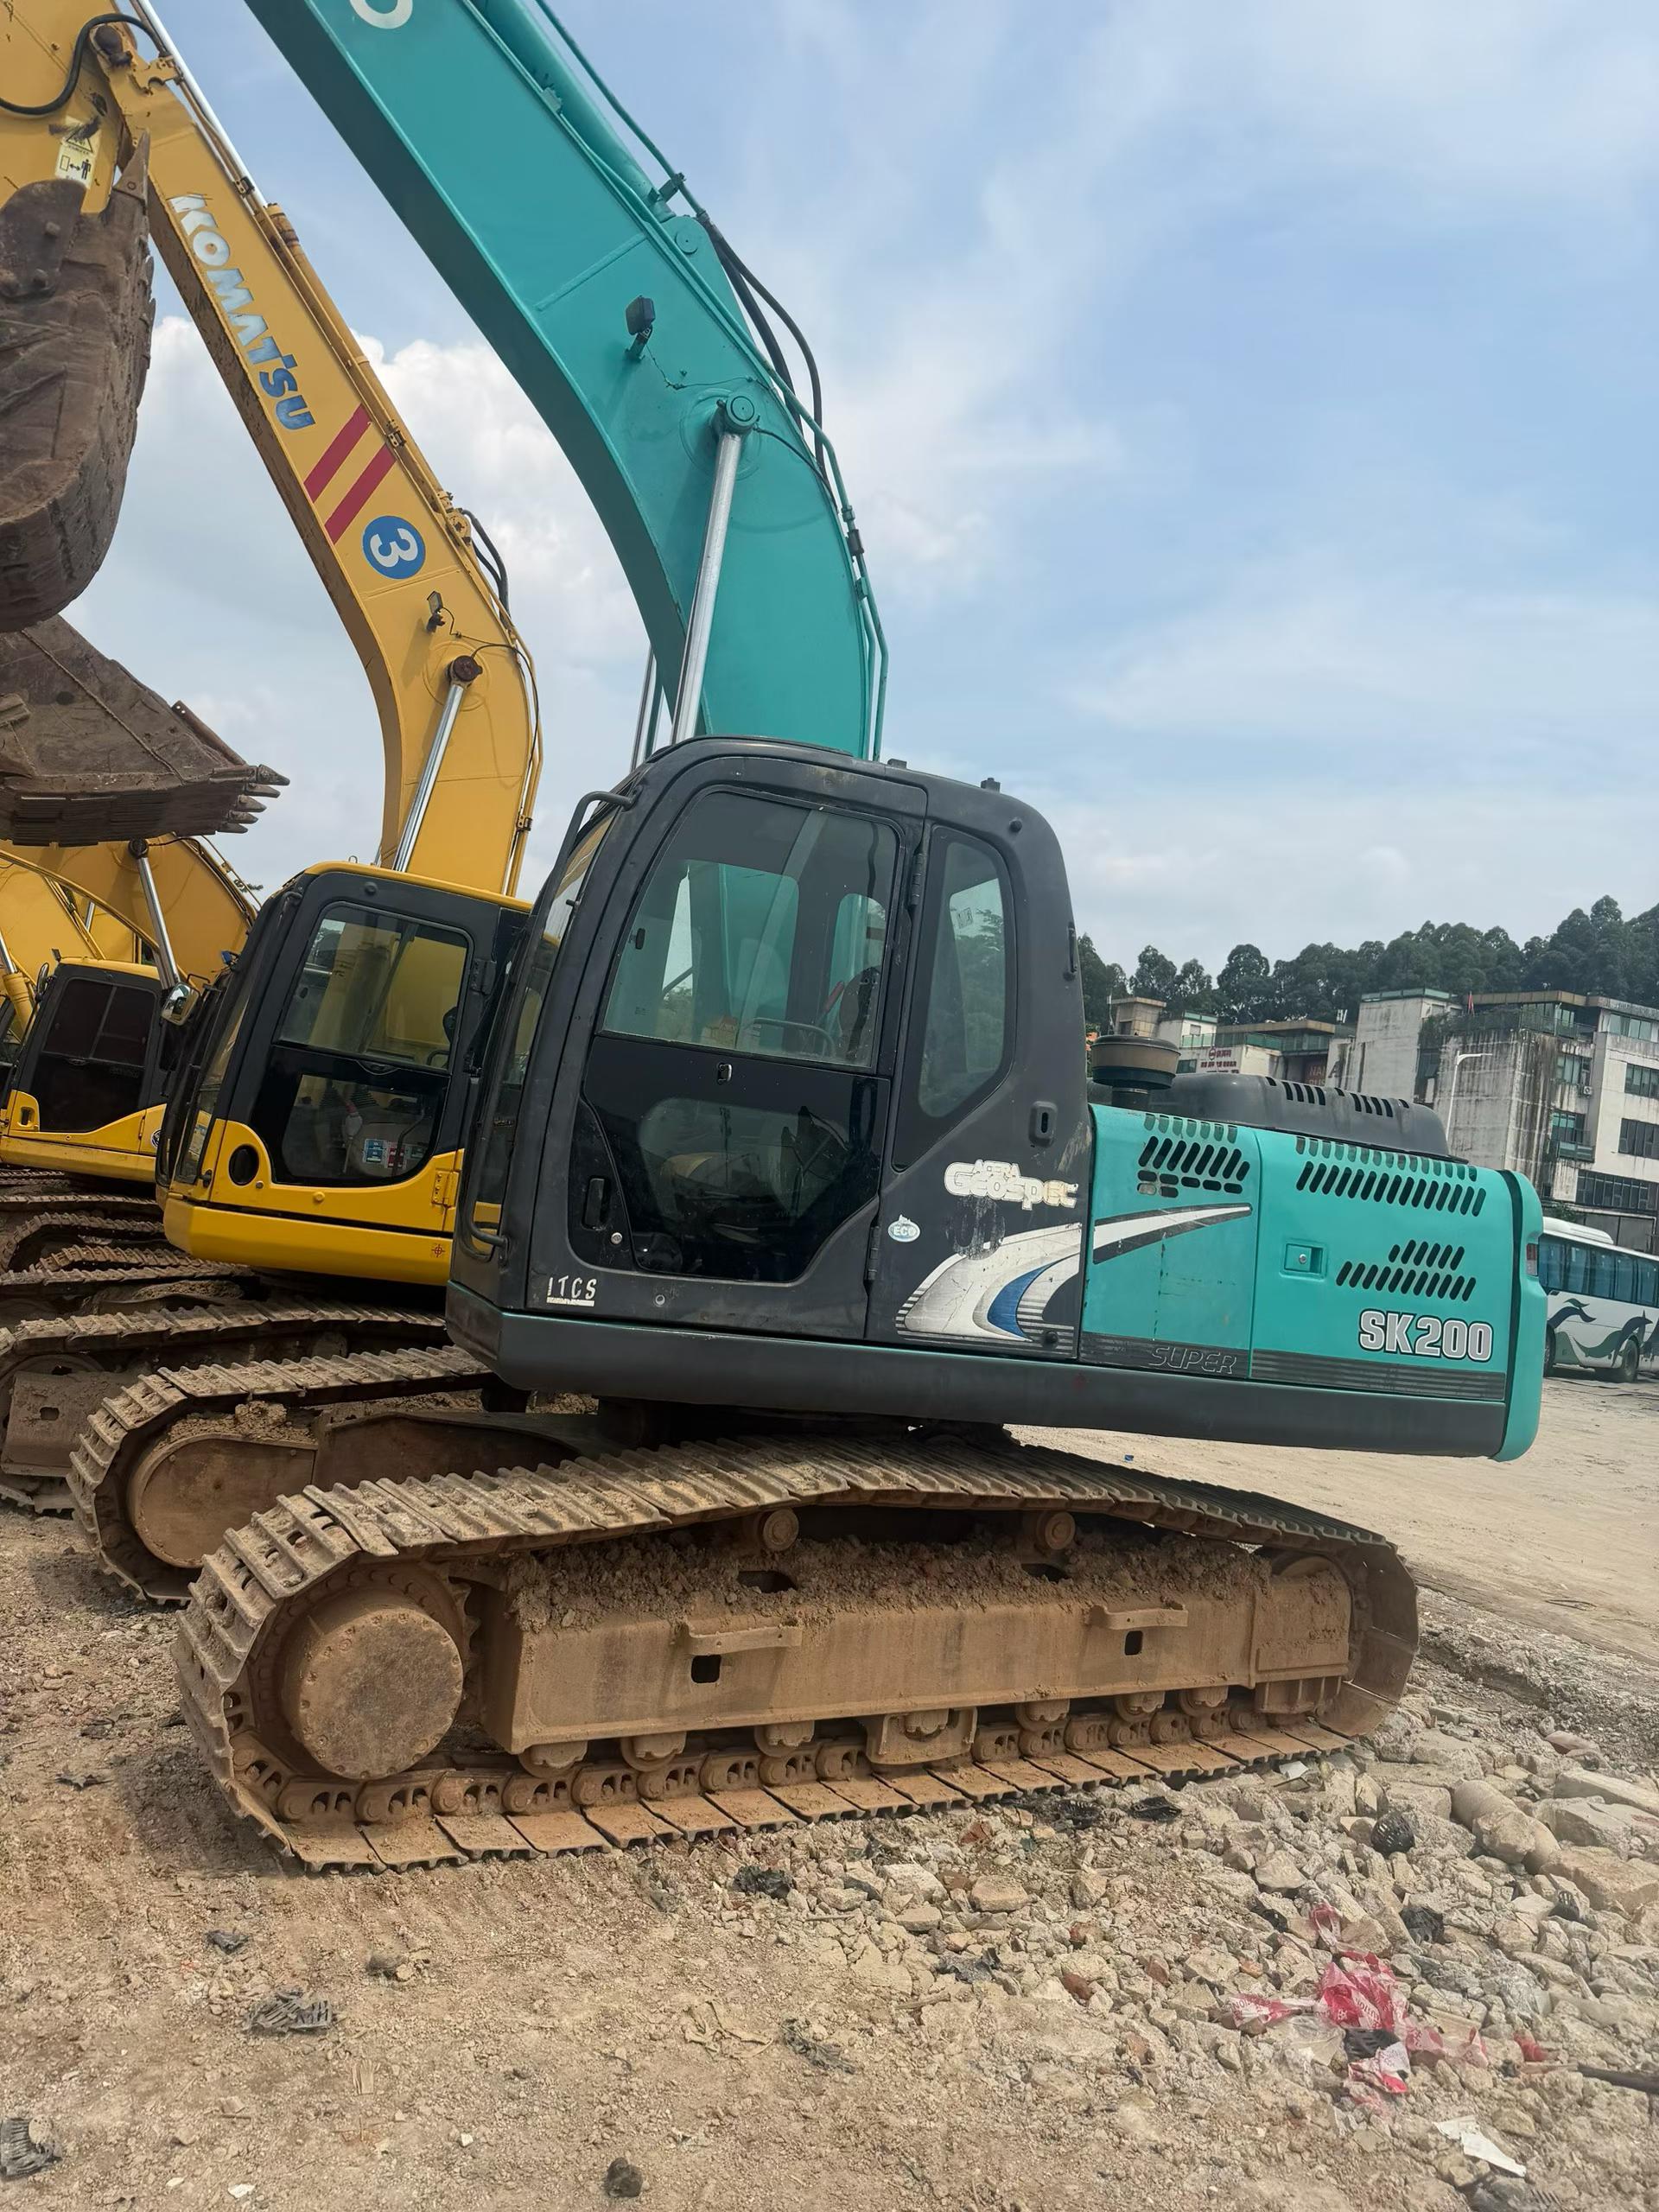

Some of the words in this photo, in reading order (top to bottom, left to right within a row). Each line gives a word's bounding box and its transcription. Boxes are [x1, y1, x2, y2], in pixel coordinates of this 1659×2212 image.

[168, 194, 316, 430] KOMATSU
[370, 527, 419, 569] 3
[547, 1274, 597, 1300] ITCS
[1358, 1309, 1494, 1363] SK200
[1148, 1345, 1237, 1376] SUPER
